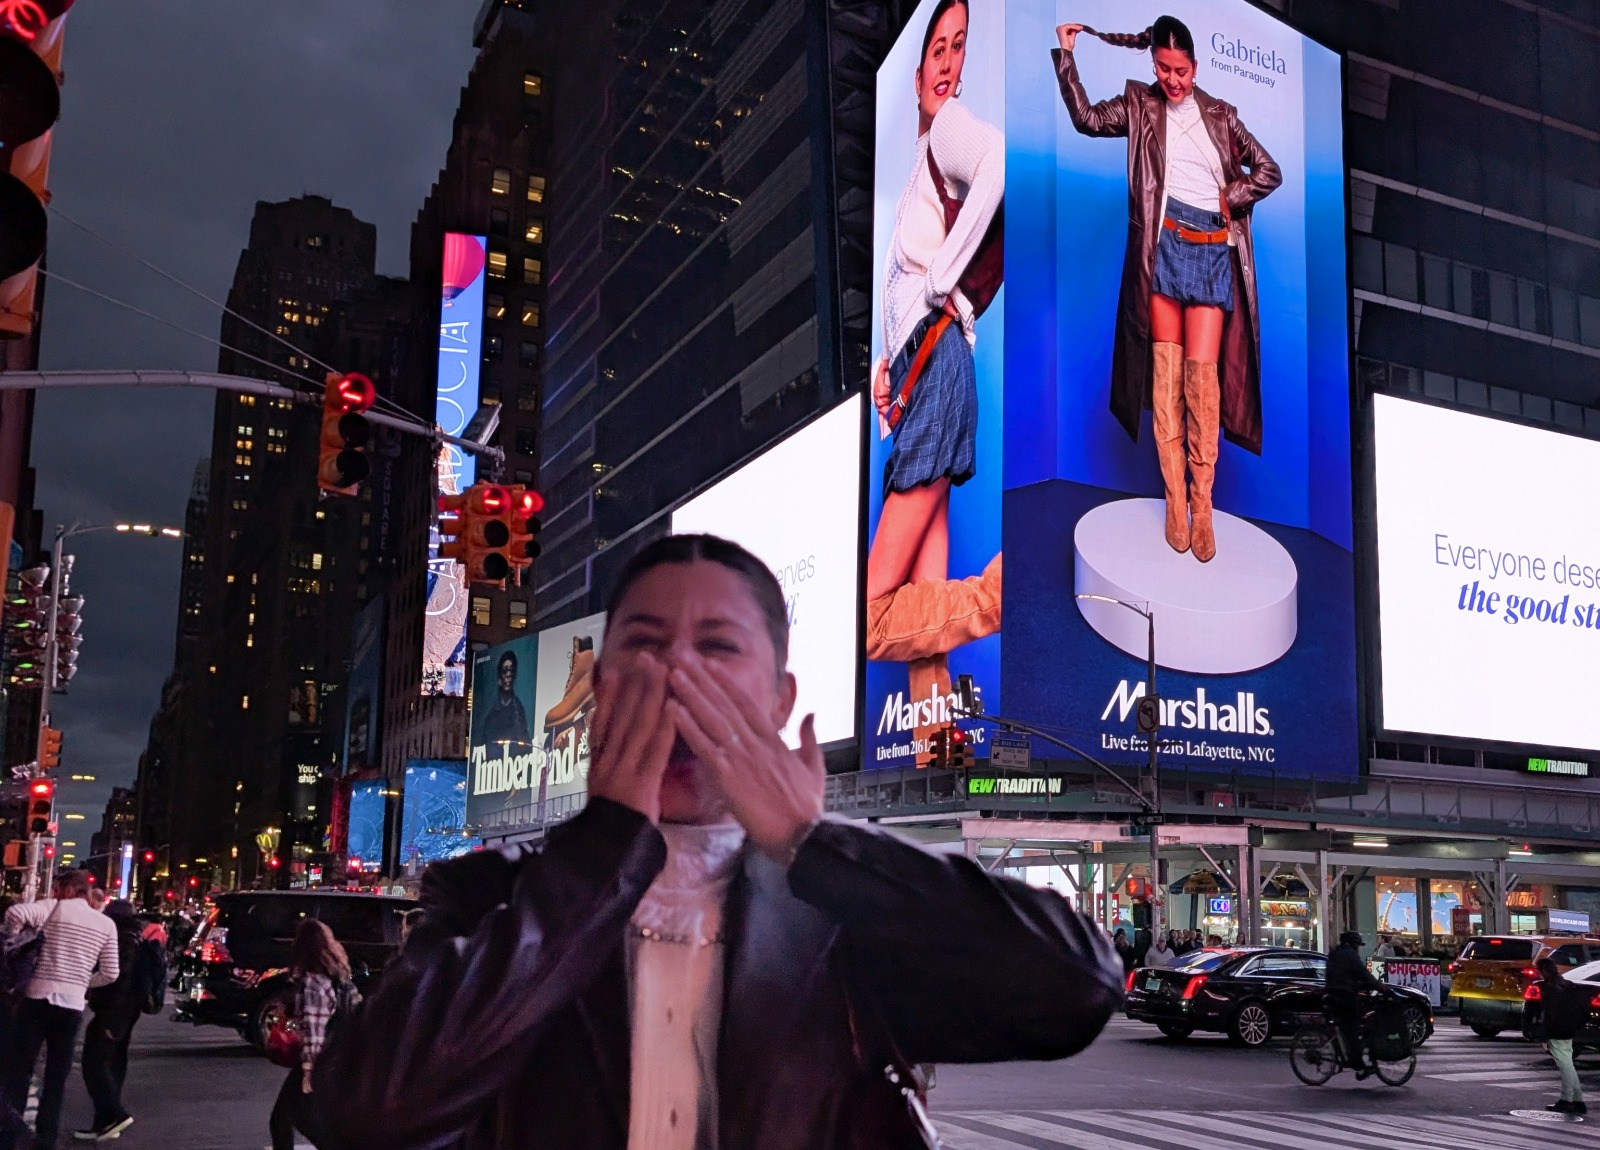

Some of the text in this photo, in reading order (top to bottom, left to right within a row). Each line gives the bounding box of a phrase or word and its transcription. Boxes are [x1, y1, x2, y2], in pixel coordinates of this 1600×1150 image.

[1211, 32, 1287, 75] Gabriela
[1210, 57, 1276, 88] from Paraguay
[1435, 533, 1546, 580] Everyone
[1458, 580, 1501, 615] the
[1503, 594, 1570, 625] good
[876, 683, 984, 736] Marshal
[472, 727, 575, 796] Timberland
[877, 746, 893, 761] Live
[892, 743, 910, 759] from
[910, 739, 924, 754] 216
[1102, 733, 1275, 763] Live fro 216 Lafayette, NYC
[298, 764, 313, 774] You
[1527, 757, 1588, 776] NEWTRADITION
[1388, 962, 1441, 976] CHICAGO
